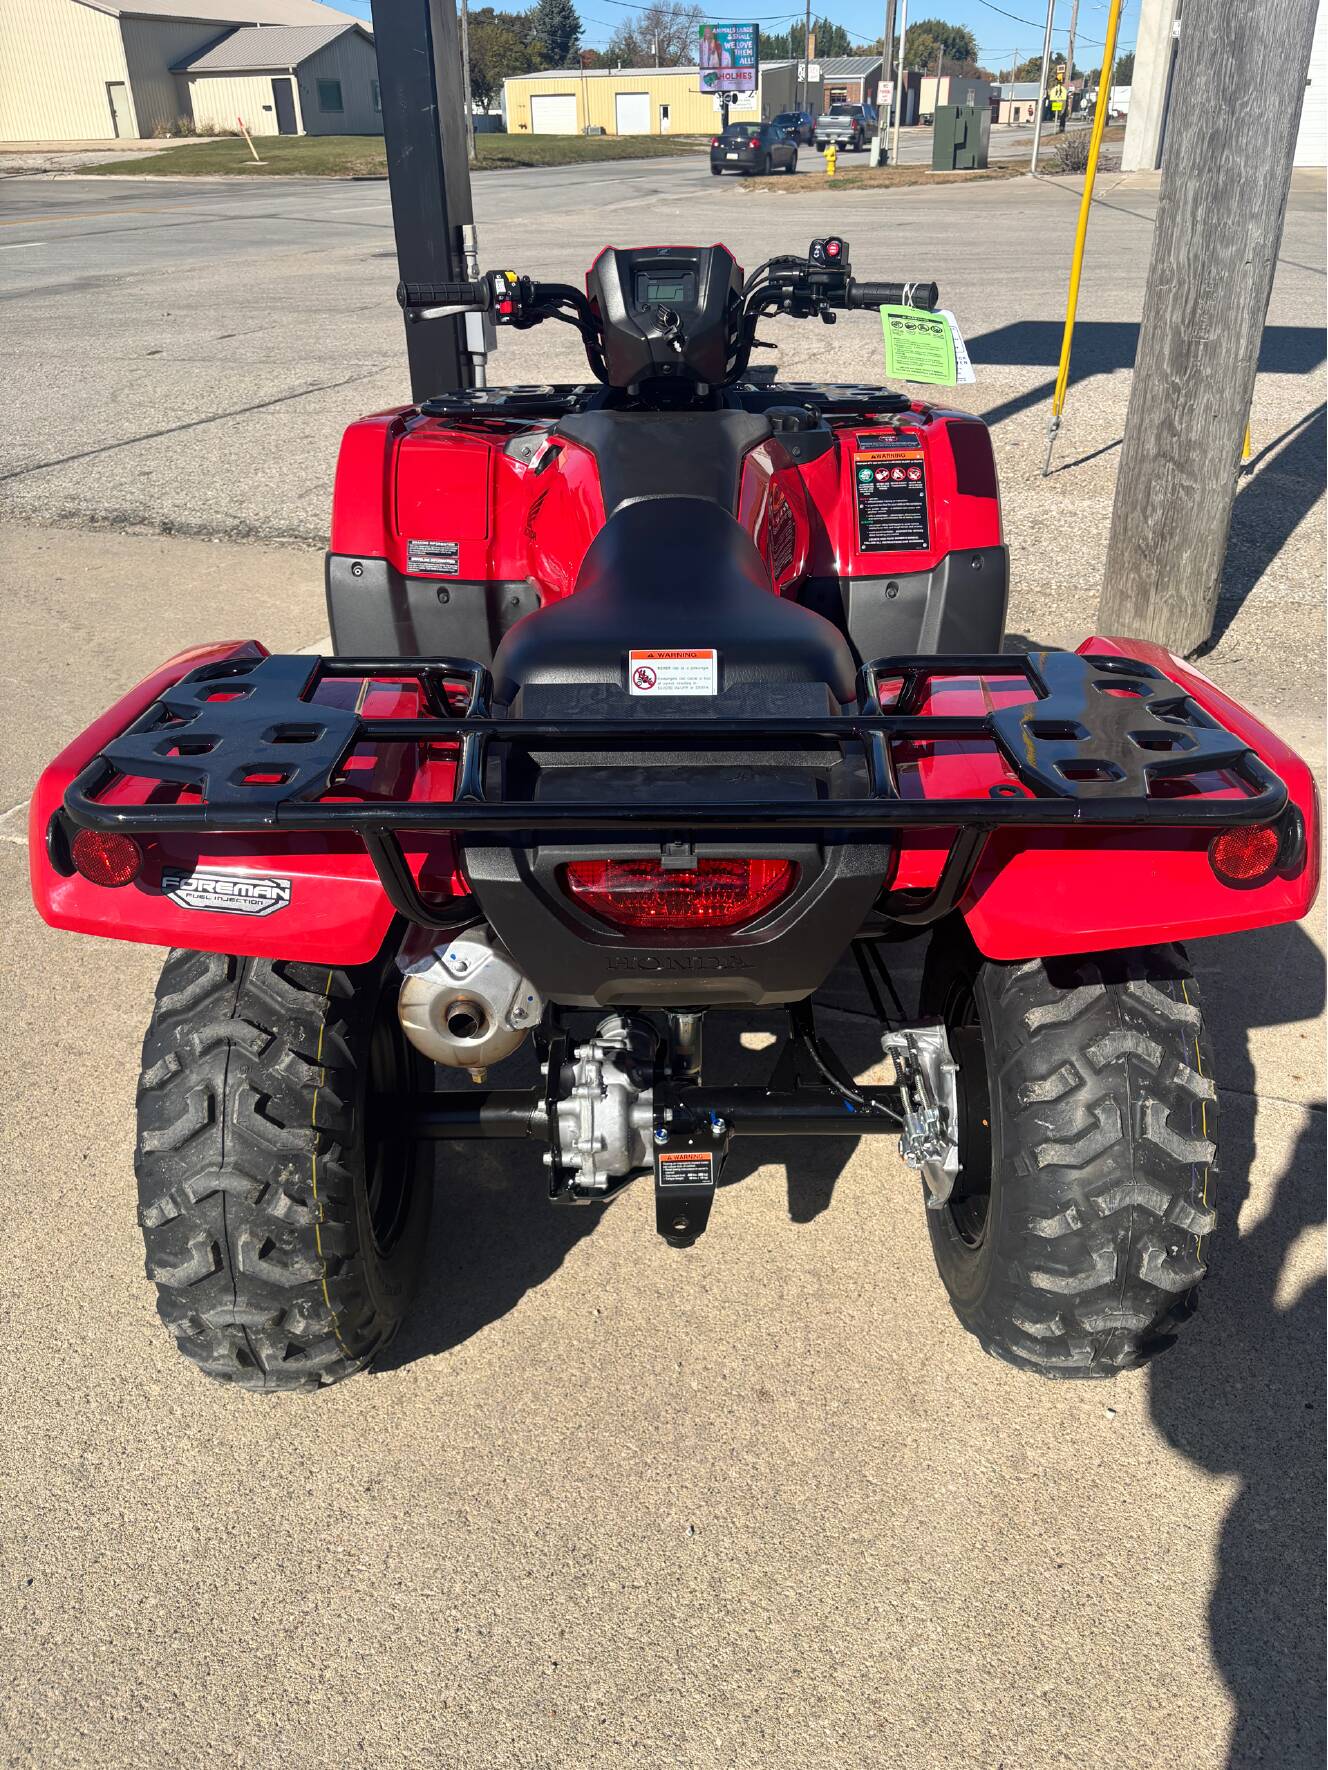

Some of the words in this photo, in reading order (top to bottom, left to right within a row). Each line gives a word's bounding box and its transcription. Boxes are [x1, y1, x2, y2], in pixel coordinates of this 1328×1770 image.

[724, 41, 736, 49] WE
[736, 41, 753, 49] LOVE
[739, 57, 754, 65] ALL!
[719, 72, 752, 80] HOLMES
[161, 876, 290, 901] FOREMAN
[185, 892, 212, 900] FUEL
[214, 895, 263, 906] INJECTION
[606, 956, 758, 970] HONDA
